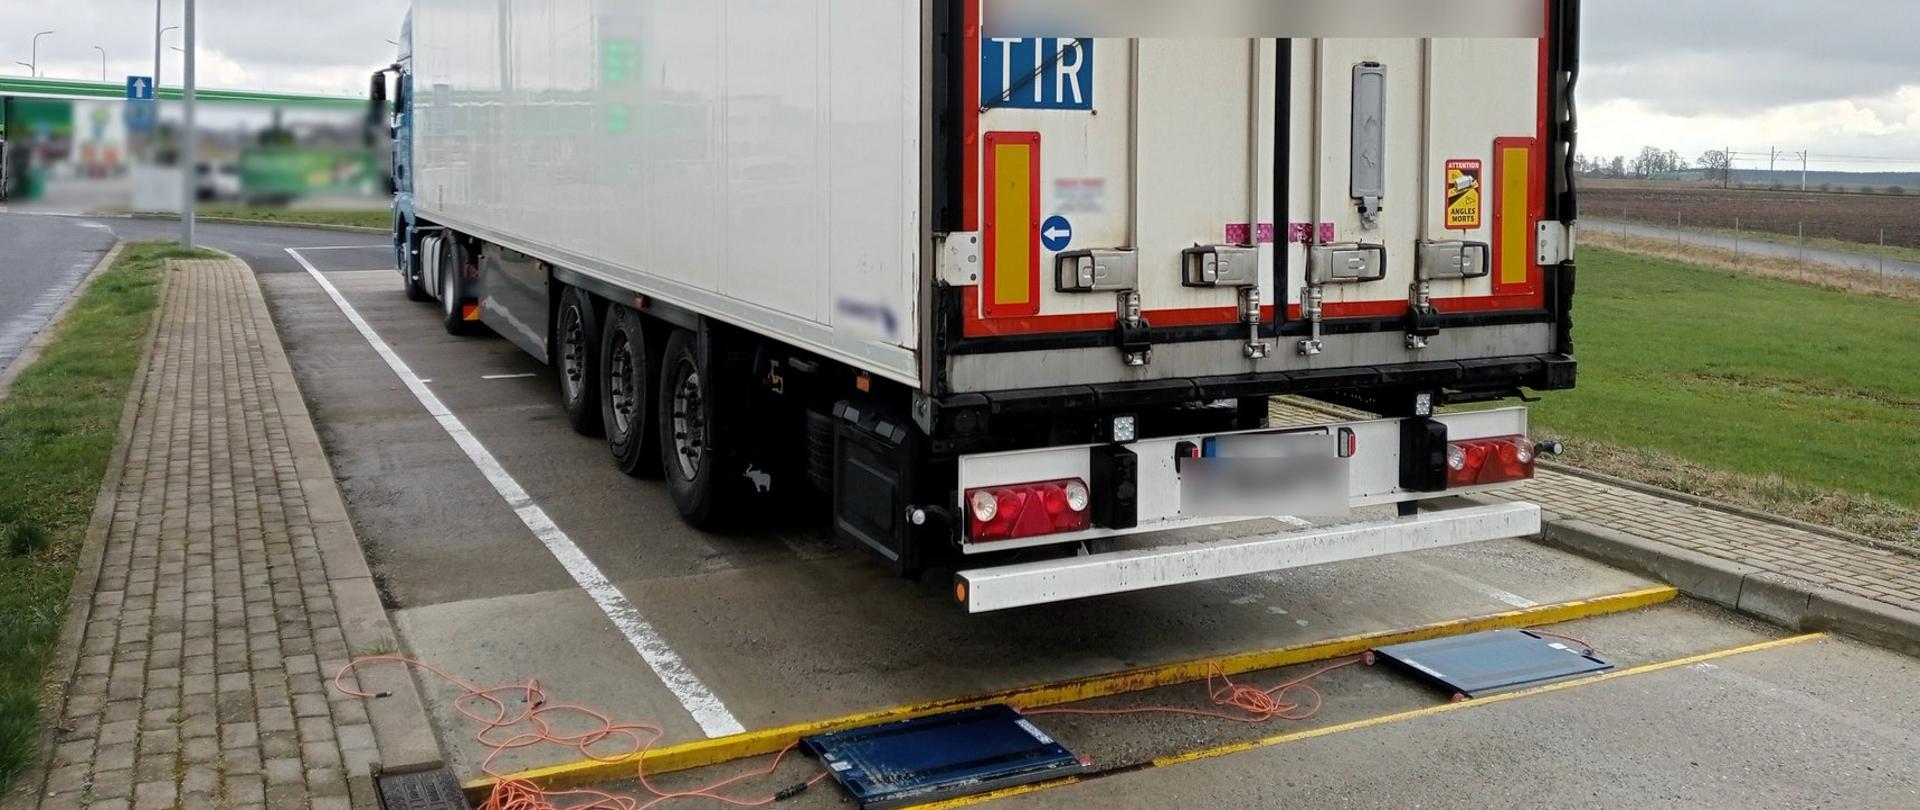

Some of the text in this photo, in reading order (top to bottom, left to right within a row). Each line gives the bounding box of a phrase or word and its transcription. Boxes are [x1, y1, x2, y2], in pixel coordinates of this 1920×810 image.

[992, 37, 1083, 103] TIR
[1451, 207, 1476, 215] ANGLES
[1452, 215, 1475, 223] MORTS
